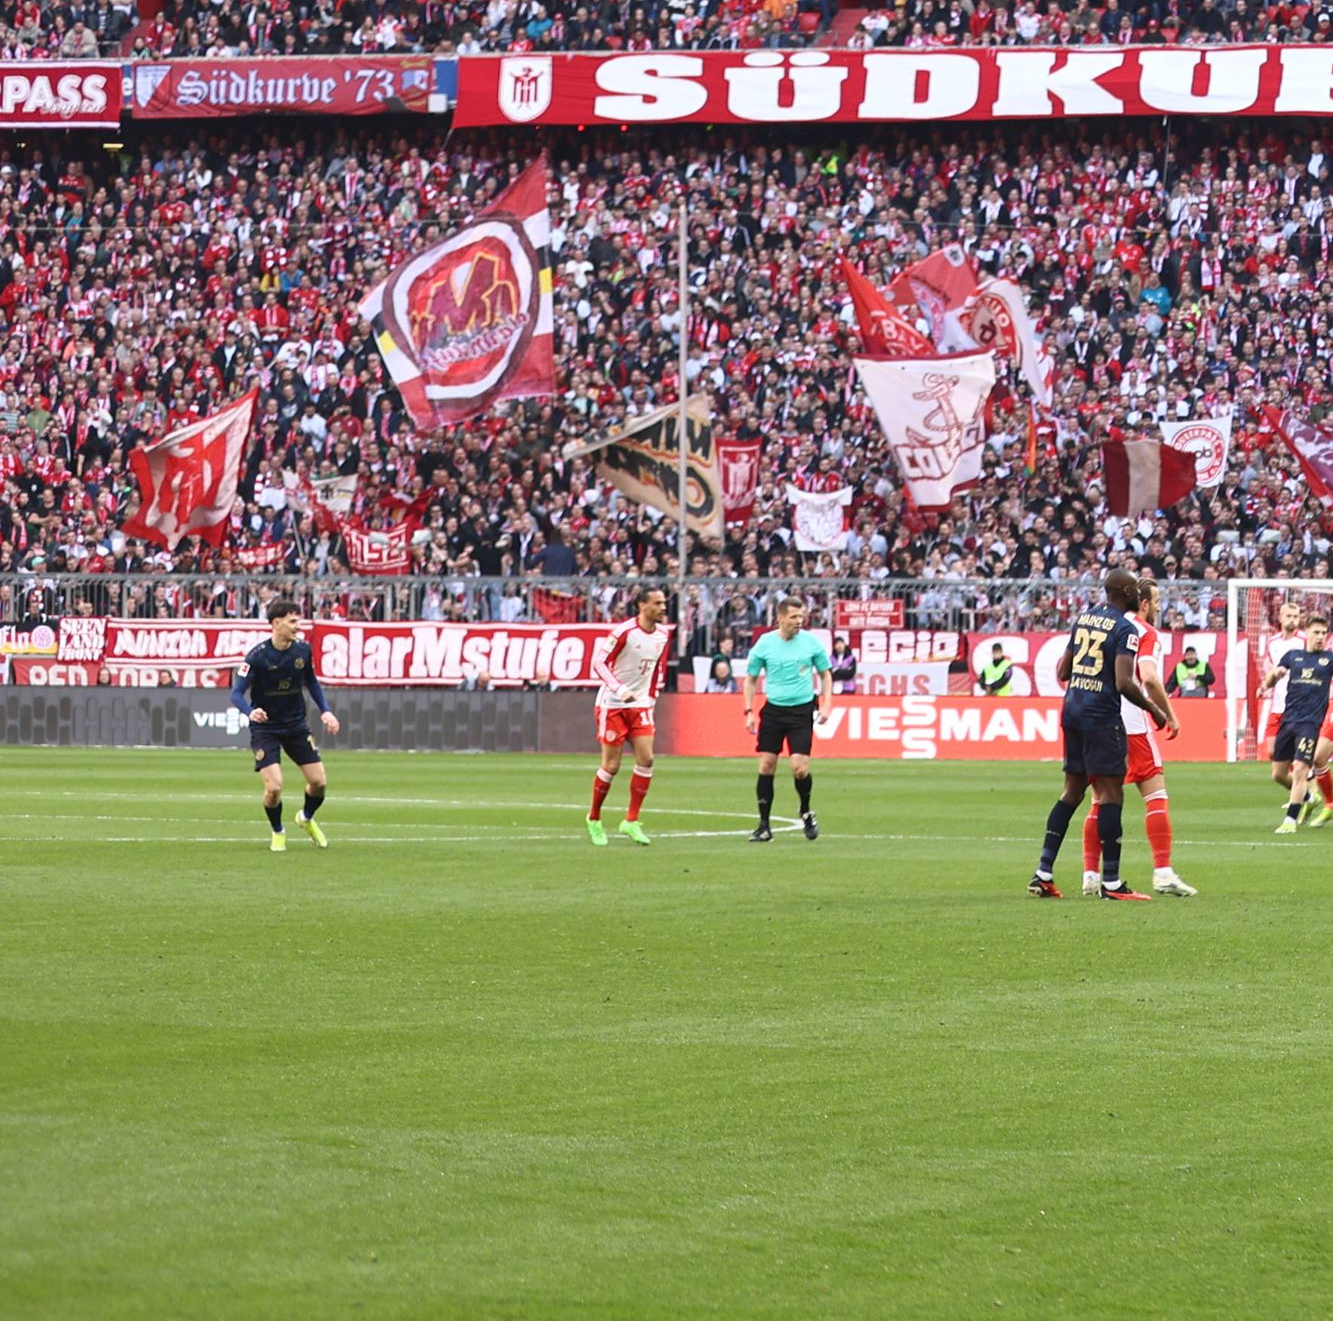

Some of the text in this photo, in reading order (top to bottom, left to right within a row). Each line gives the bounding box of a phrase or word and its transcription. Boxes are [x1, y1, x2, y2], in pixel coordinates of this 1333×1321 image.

[176, 68, 337, 107] Südkurve
[60, 618, 108, 635] SEEN
[1079, 614, 1115, 632] MAINZ 05
[59, 634, 105, 650] LAND
[57, 647, 103, 662] FRONT
[321, 626, 585, 680] alarMstufe
[1072, 628, 1108, 677] 23
[813, 696, 1059, 759] VIESSMAN
[1297, 738, 1313, 754] 43
